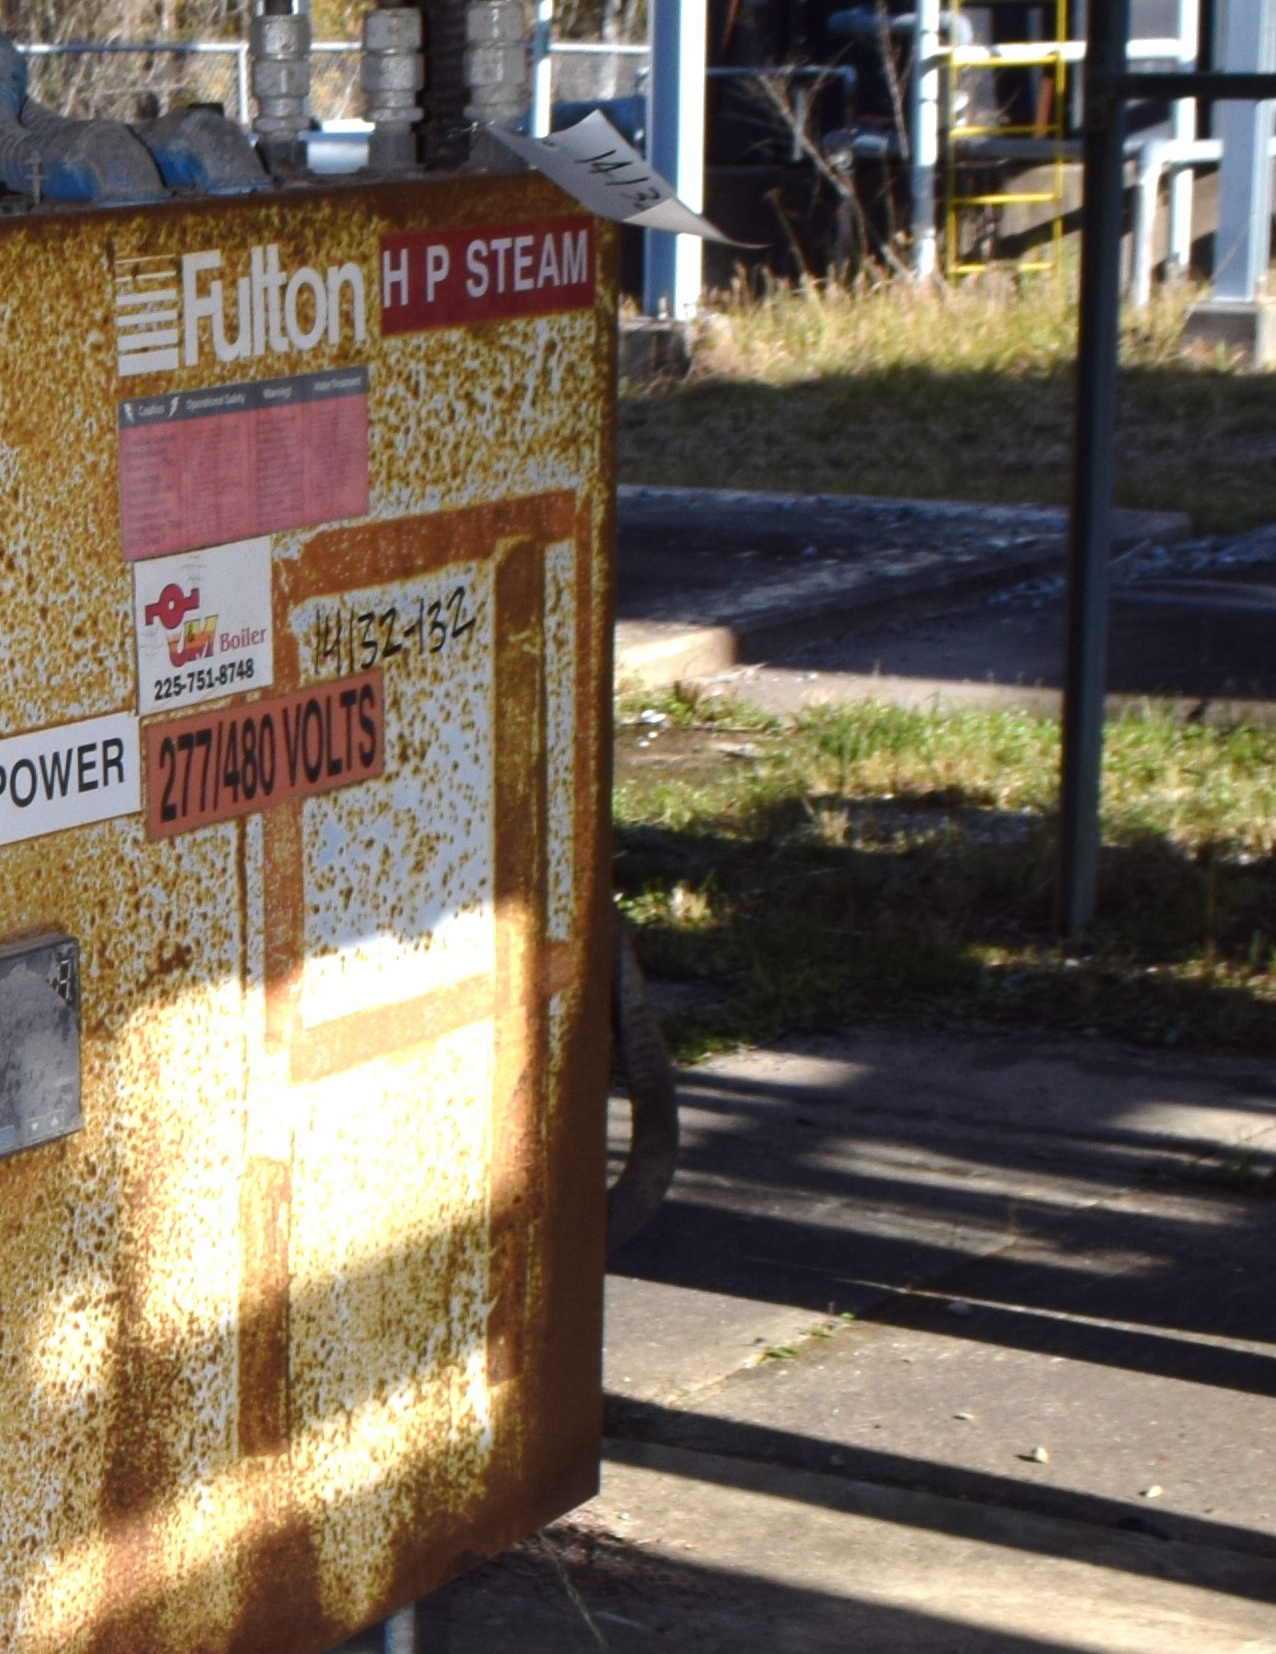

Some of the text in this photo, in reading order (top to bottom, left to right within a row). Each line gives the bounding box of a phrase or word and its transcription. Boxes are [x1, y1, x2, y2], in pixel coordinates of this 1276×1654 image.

[182, 244, 366, 366] Fulton
[382, 229, 588, 308] H P STEAM
[154, 658, 255, 700] 225-751-8748
[220, 628, 267, 652] Boiler
[159, 683, 377, 823] 277/480 VOLTS
